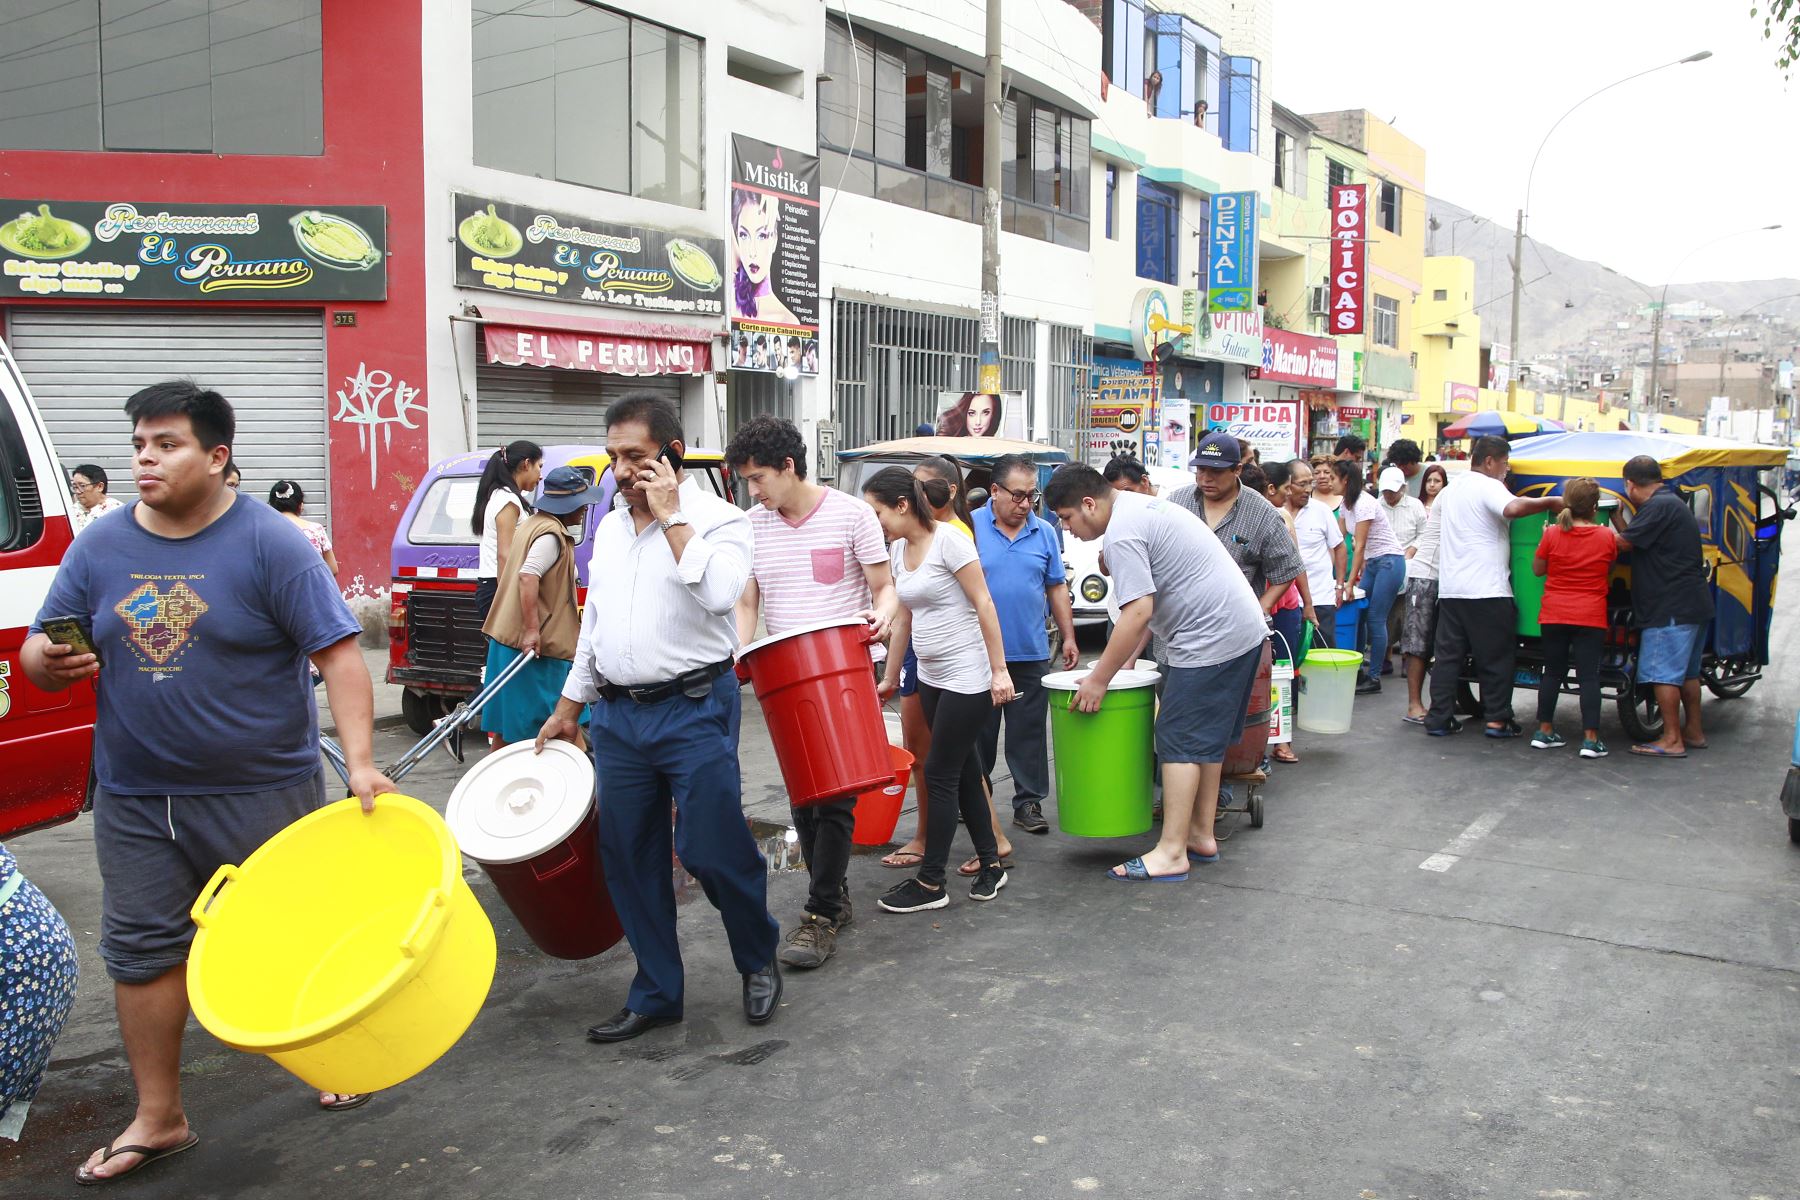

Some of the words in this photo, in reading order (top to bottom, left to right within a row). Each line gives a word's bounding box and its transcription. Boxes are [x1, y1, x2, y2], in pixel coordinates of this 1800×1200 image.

[744, 161, 809, 196] Mistika
[96, 204, 259, 241] Restaurant
[526, 215, 641, 253] Restaurant
[1215, 196, 1236, 284] DENTAL
[139, 234, 177, 264] El
[179, 244, 311, 286] Peruano
[555, 245, 580, 266] El
[585, 251, 672, 286] Peruano
[1335, 190, 1359, 330] BOTICAS
[581, 287, 605, 301] Av.
[608, 290, 632, 305] Los
[697, 299, 721, 312] 375
[335, 315, 354, 324] 375
[741, 323, 760, 331] Corte
[777, 328, 811, 337] Caballeros
[517, 333, 556, 360] EL
[1273, 343, 1308, 376] Marino
[1308, 349, 1336, 380] Farma
[1210, 405, 1292, 423] OPTICA
[1230, 424, 1292, 440] Future
